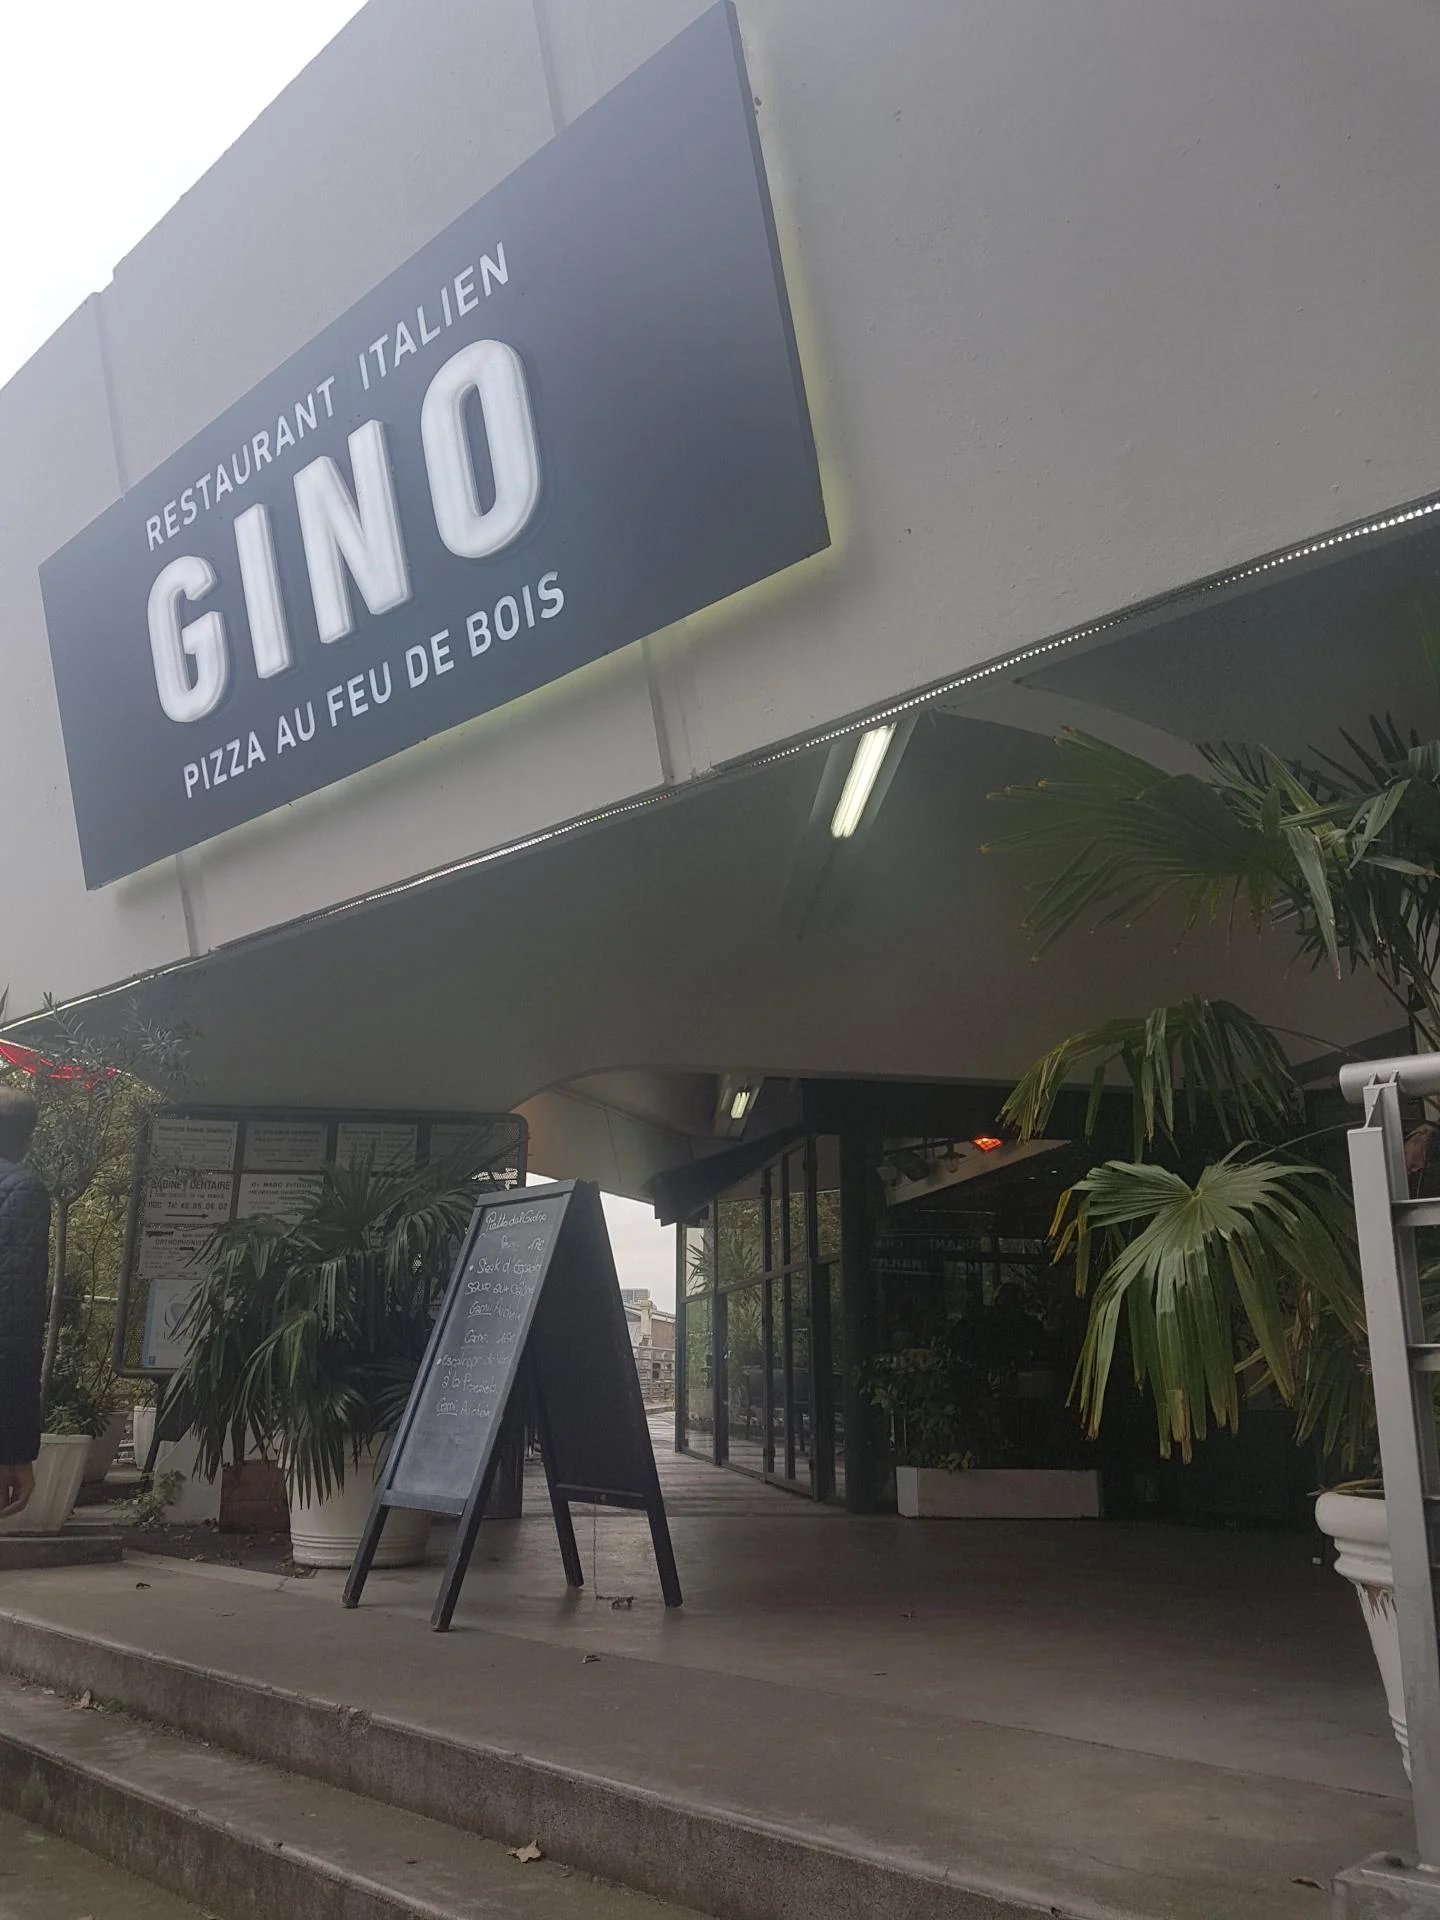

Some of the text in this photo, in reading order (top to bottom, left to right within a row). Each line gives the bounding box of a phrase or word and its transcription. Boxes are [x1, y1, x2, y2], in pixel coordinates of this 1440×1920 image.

[146, 241, 510, 551] RESTAURANT ITALIEN
[146, 338, 541, 724] GINO
[182, 571, 566, 799] PIZZA AU FEU DE BOIS
[189, 1178, 231, 1191] DENTAIRE
